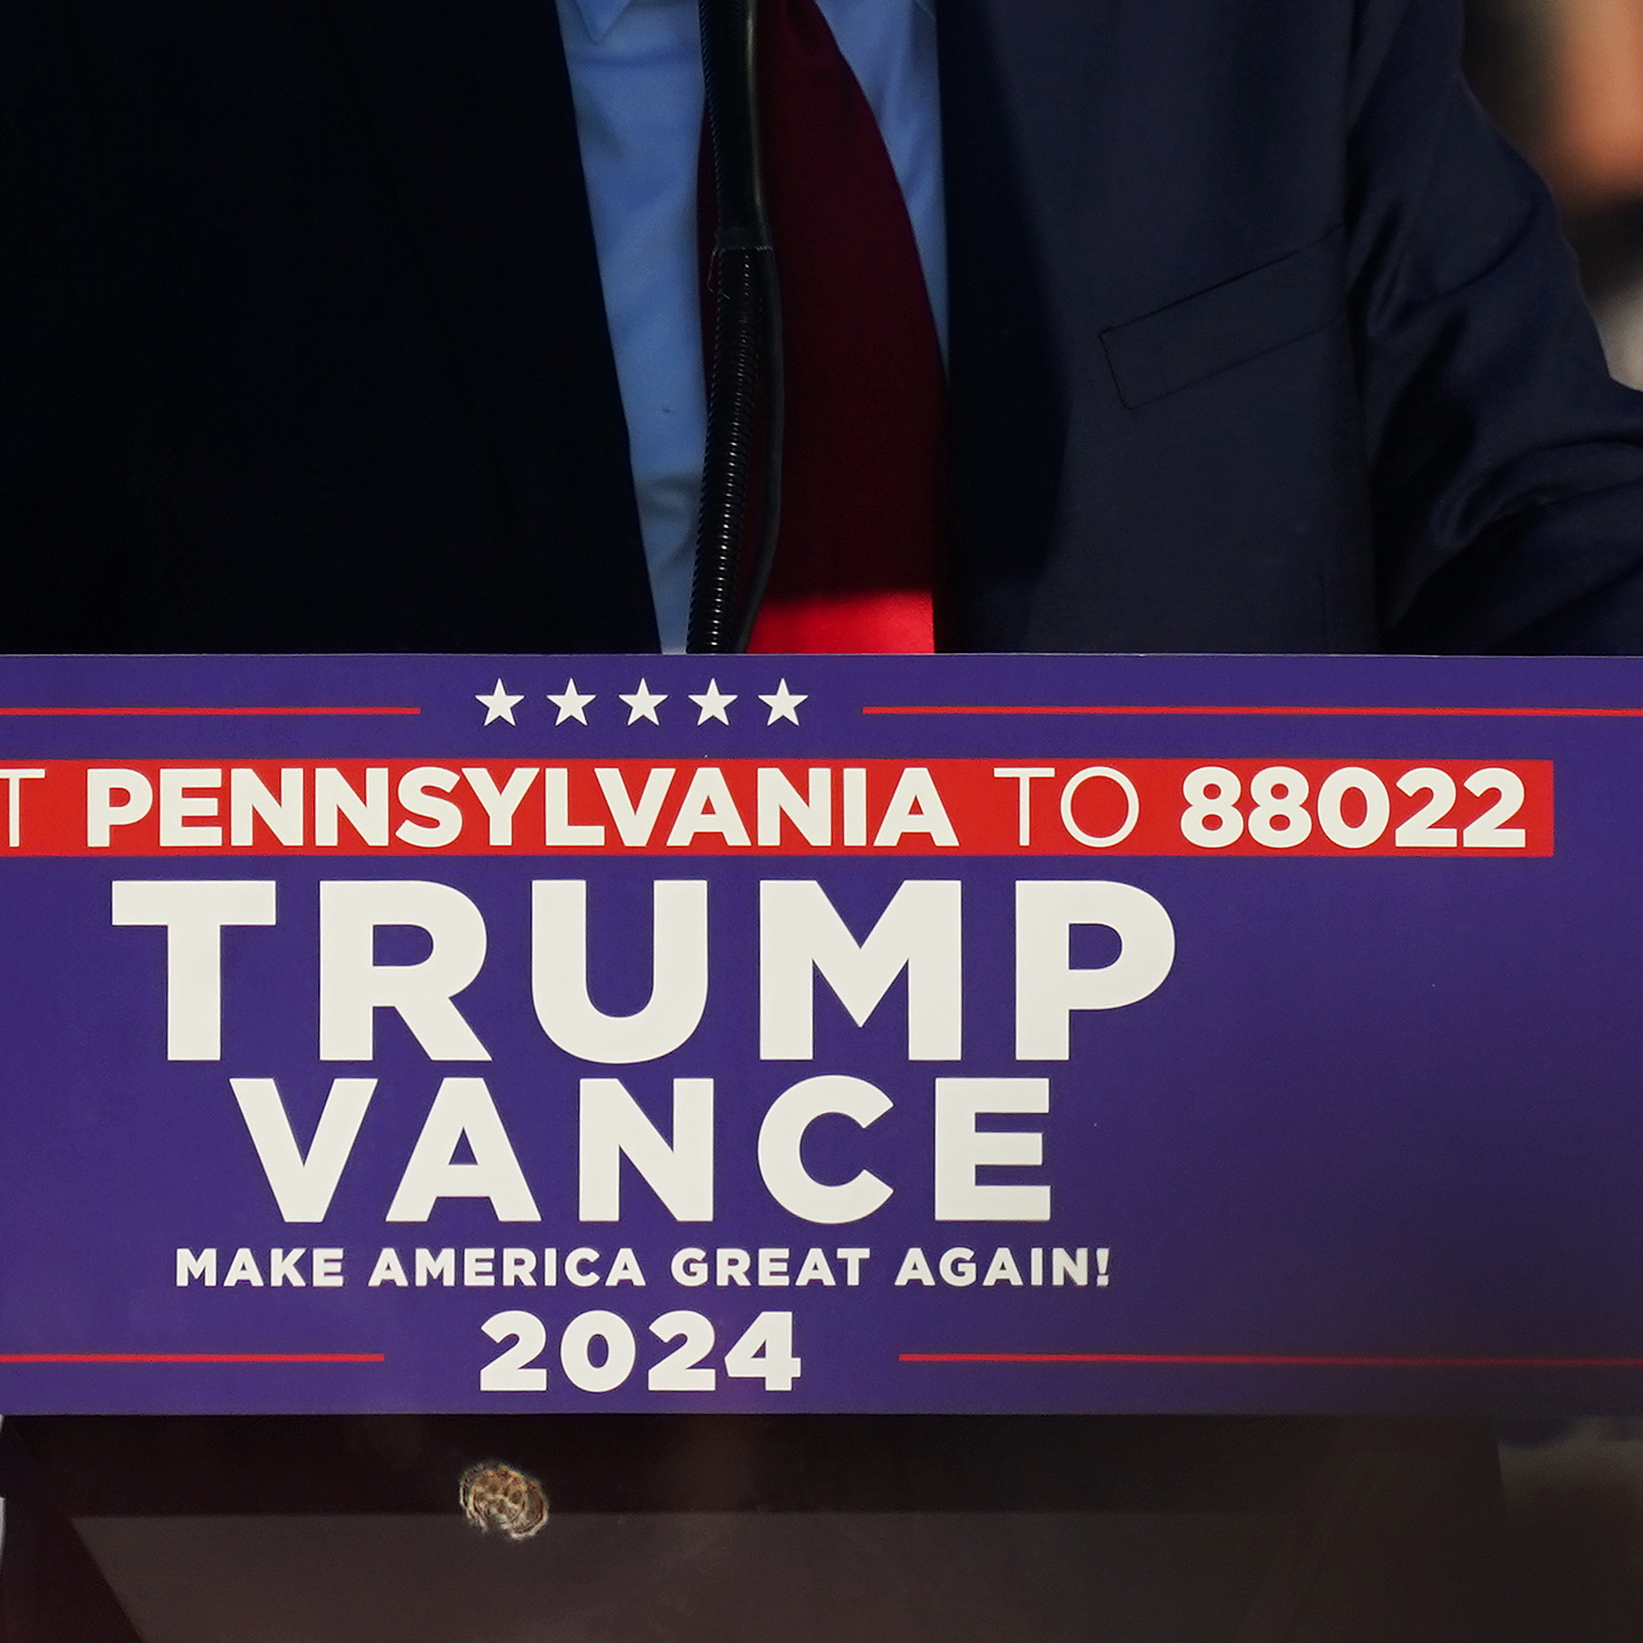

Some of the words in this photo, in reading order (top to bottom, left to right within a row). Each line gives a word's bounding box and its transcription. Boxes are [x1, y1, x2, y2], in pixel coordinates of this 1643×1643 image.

[86, 767, 960, 847] PENNSYLVANIA
[993, 766, 1140, 848] TO
[1180, 766, 1526, 849] 88022
[112, 879, 1176, 1065] TRUMP
[230, 1074, 1051, 1225] VANCE
[176, 1247, 344, 1287] MAKE
[367, 1247, 647, 1287] AMERICA
[670, 1247, 871, 1287] GREAT
[894, 1246, 1110, 1287] AGAIN!
[479, 1309, 802, 1393] 2024
